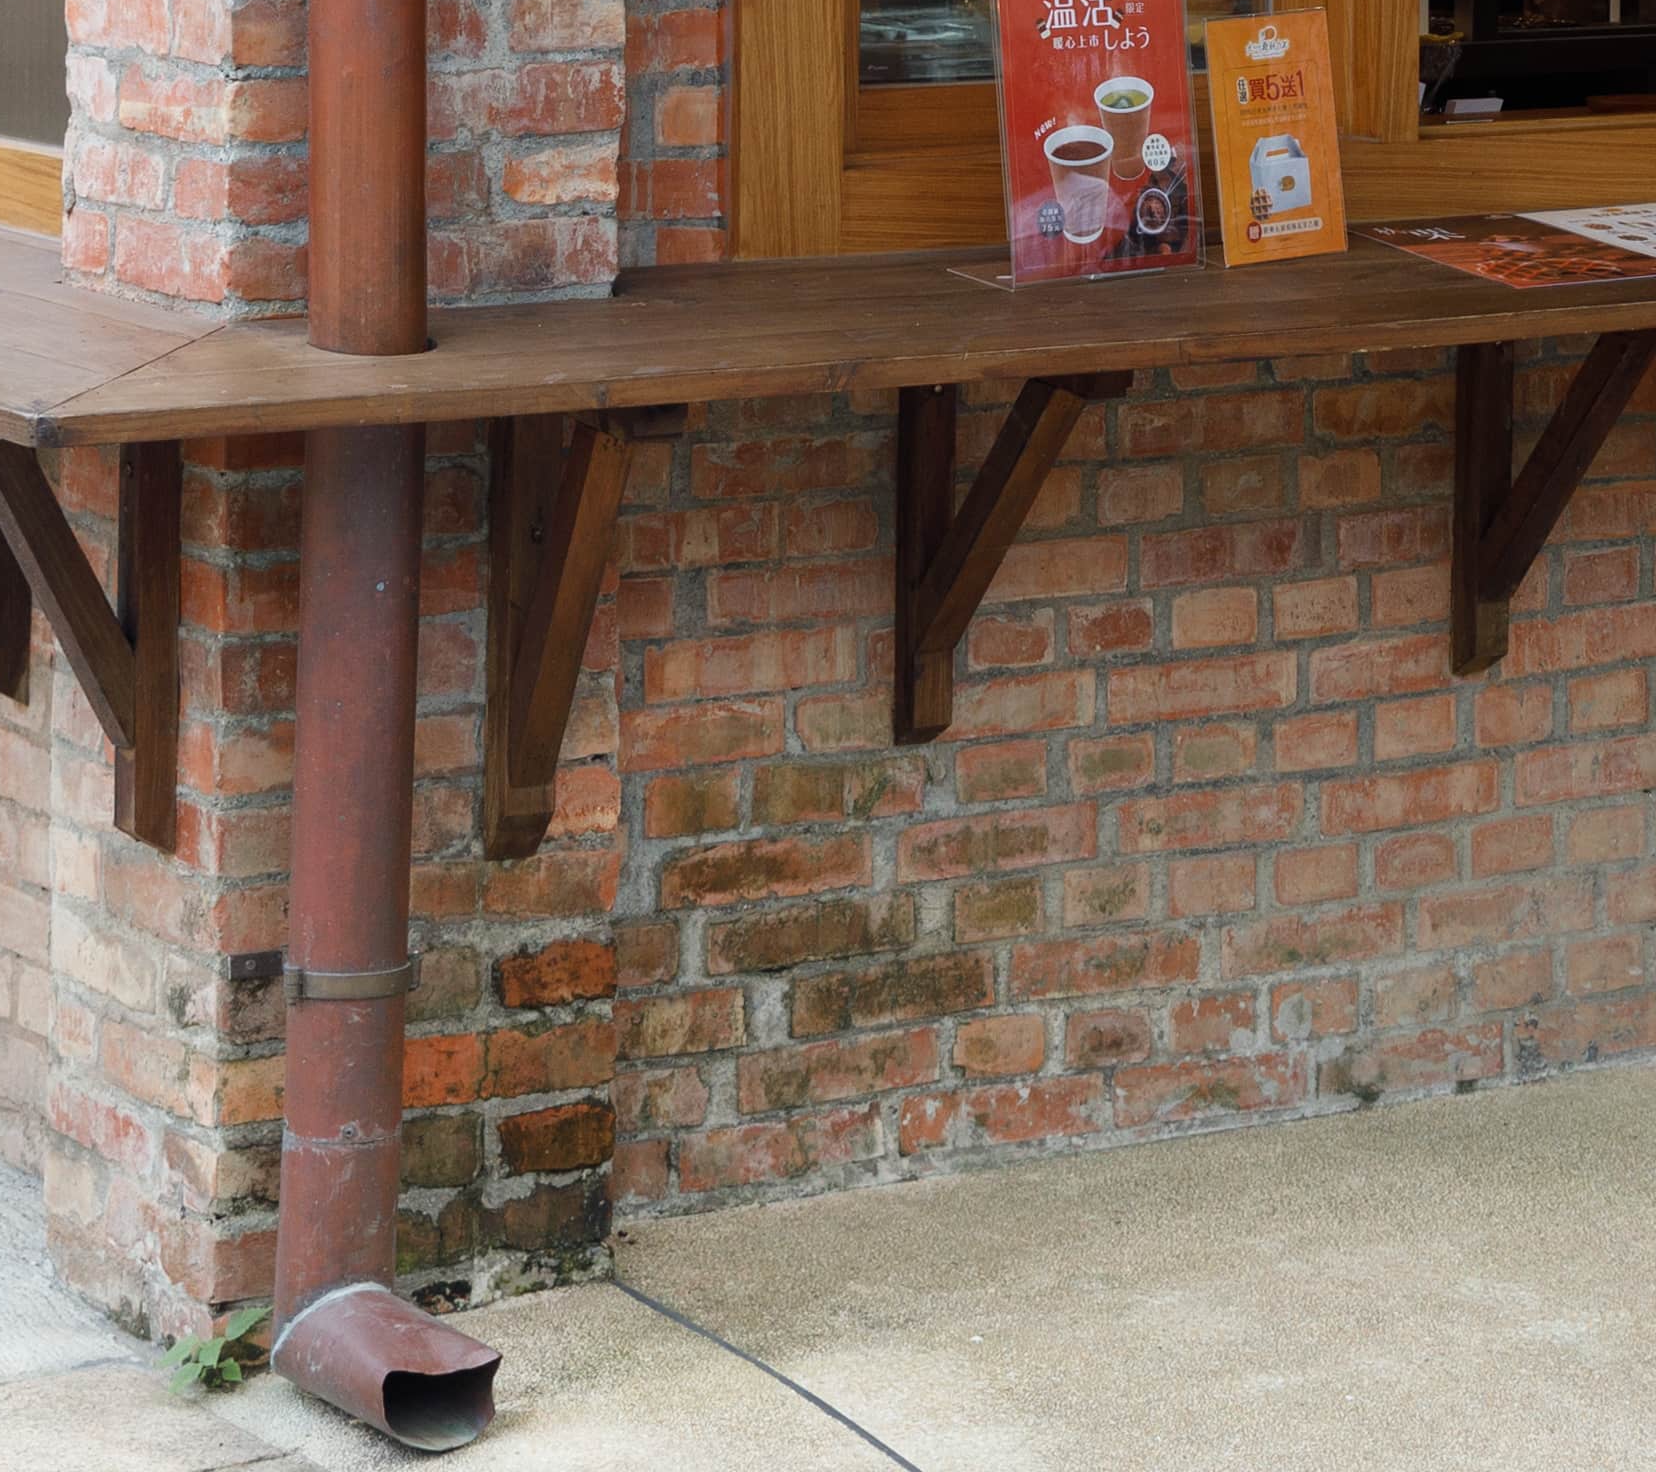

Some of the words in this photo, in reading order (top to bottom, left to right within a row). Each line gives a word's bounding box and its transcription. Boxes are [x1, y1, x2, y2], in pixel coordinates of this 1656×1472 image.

[1125, 2, 1144, 14] 限定
[1104, 26, 1150, 50] しよう
[1249, 69, 1305, 102] 買5送1
